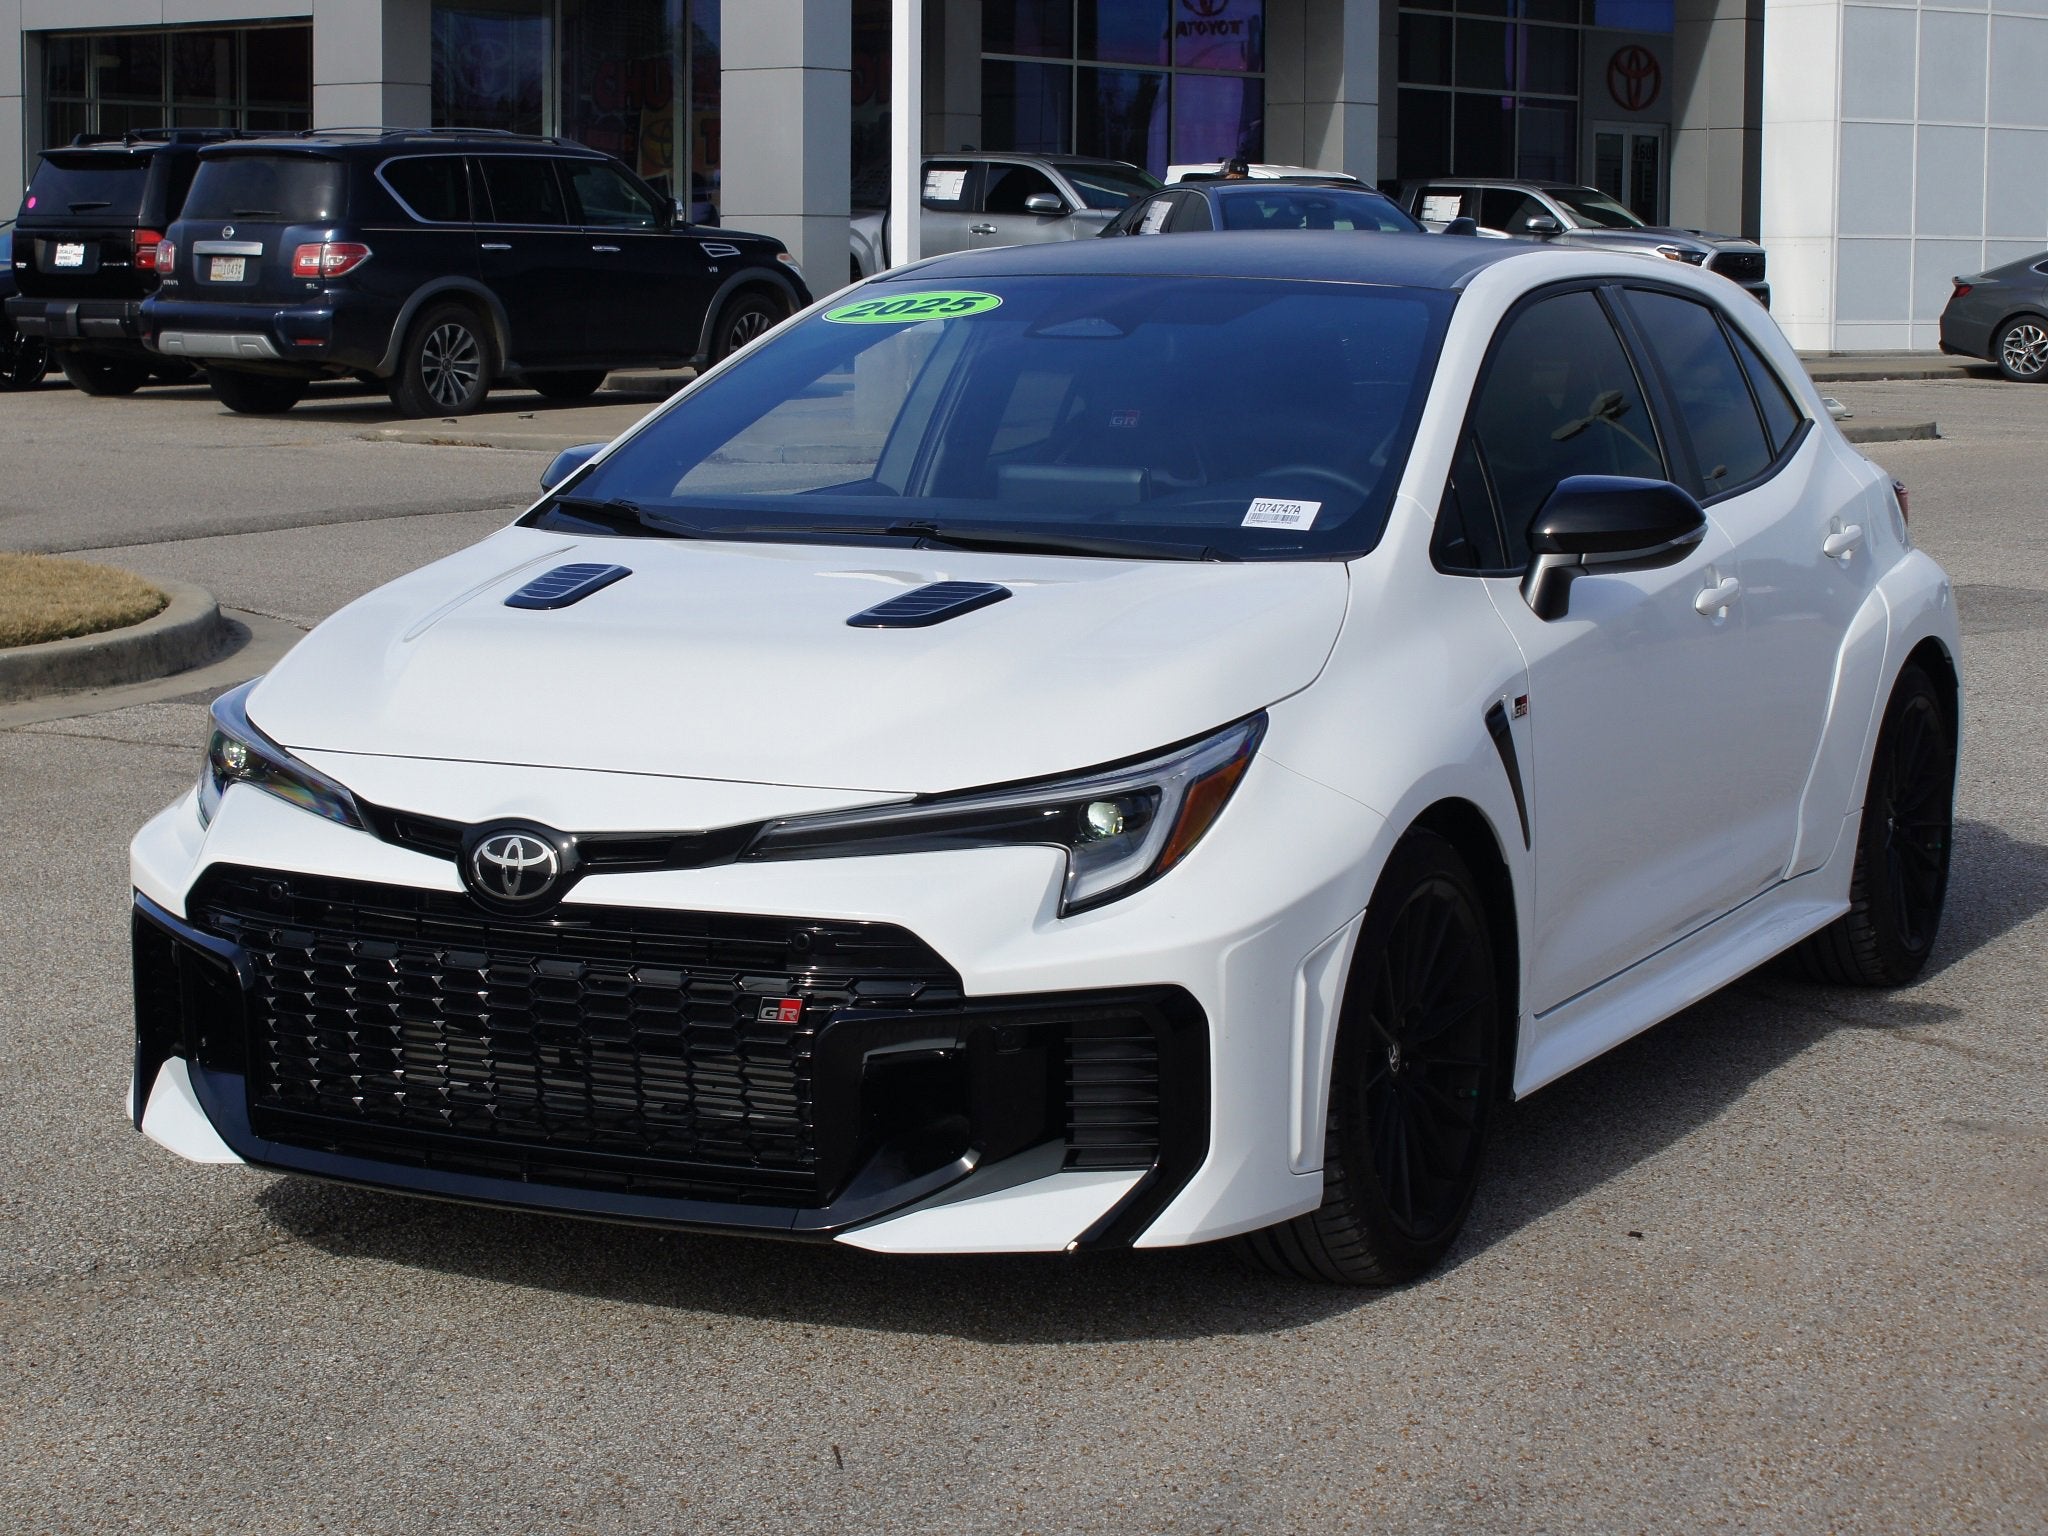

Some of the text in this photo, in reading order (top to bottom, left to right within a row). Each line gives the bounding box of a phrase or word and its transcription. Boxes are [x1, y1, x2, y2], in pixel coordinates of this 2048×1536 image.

[836, 296, 987, 319] 2025
[1111, 416, 1137, 426] GR
[760, 1006, 798, 1021] GR
